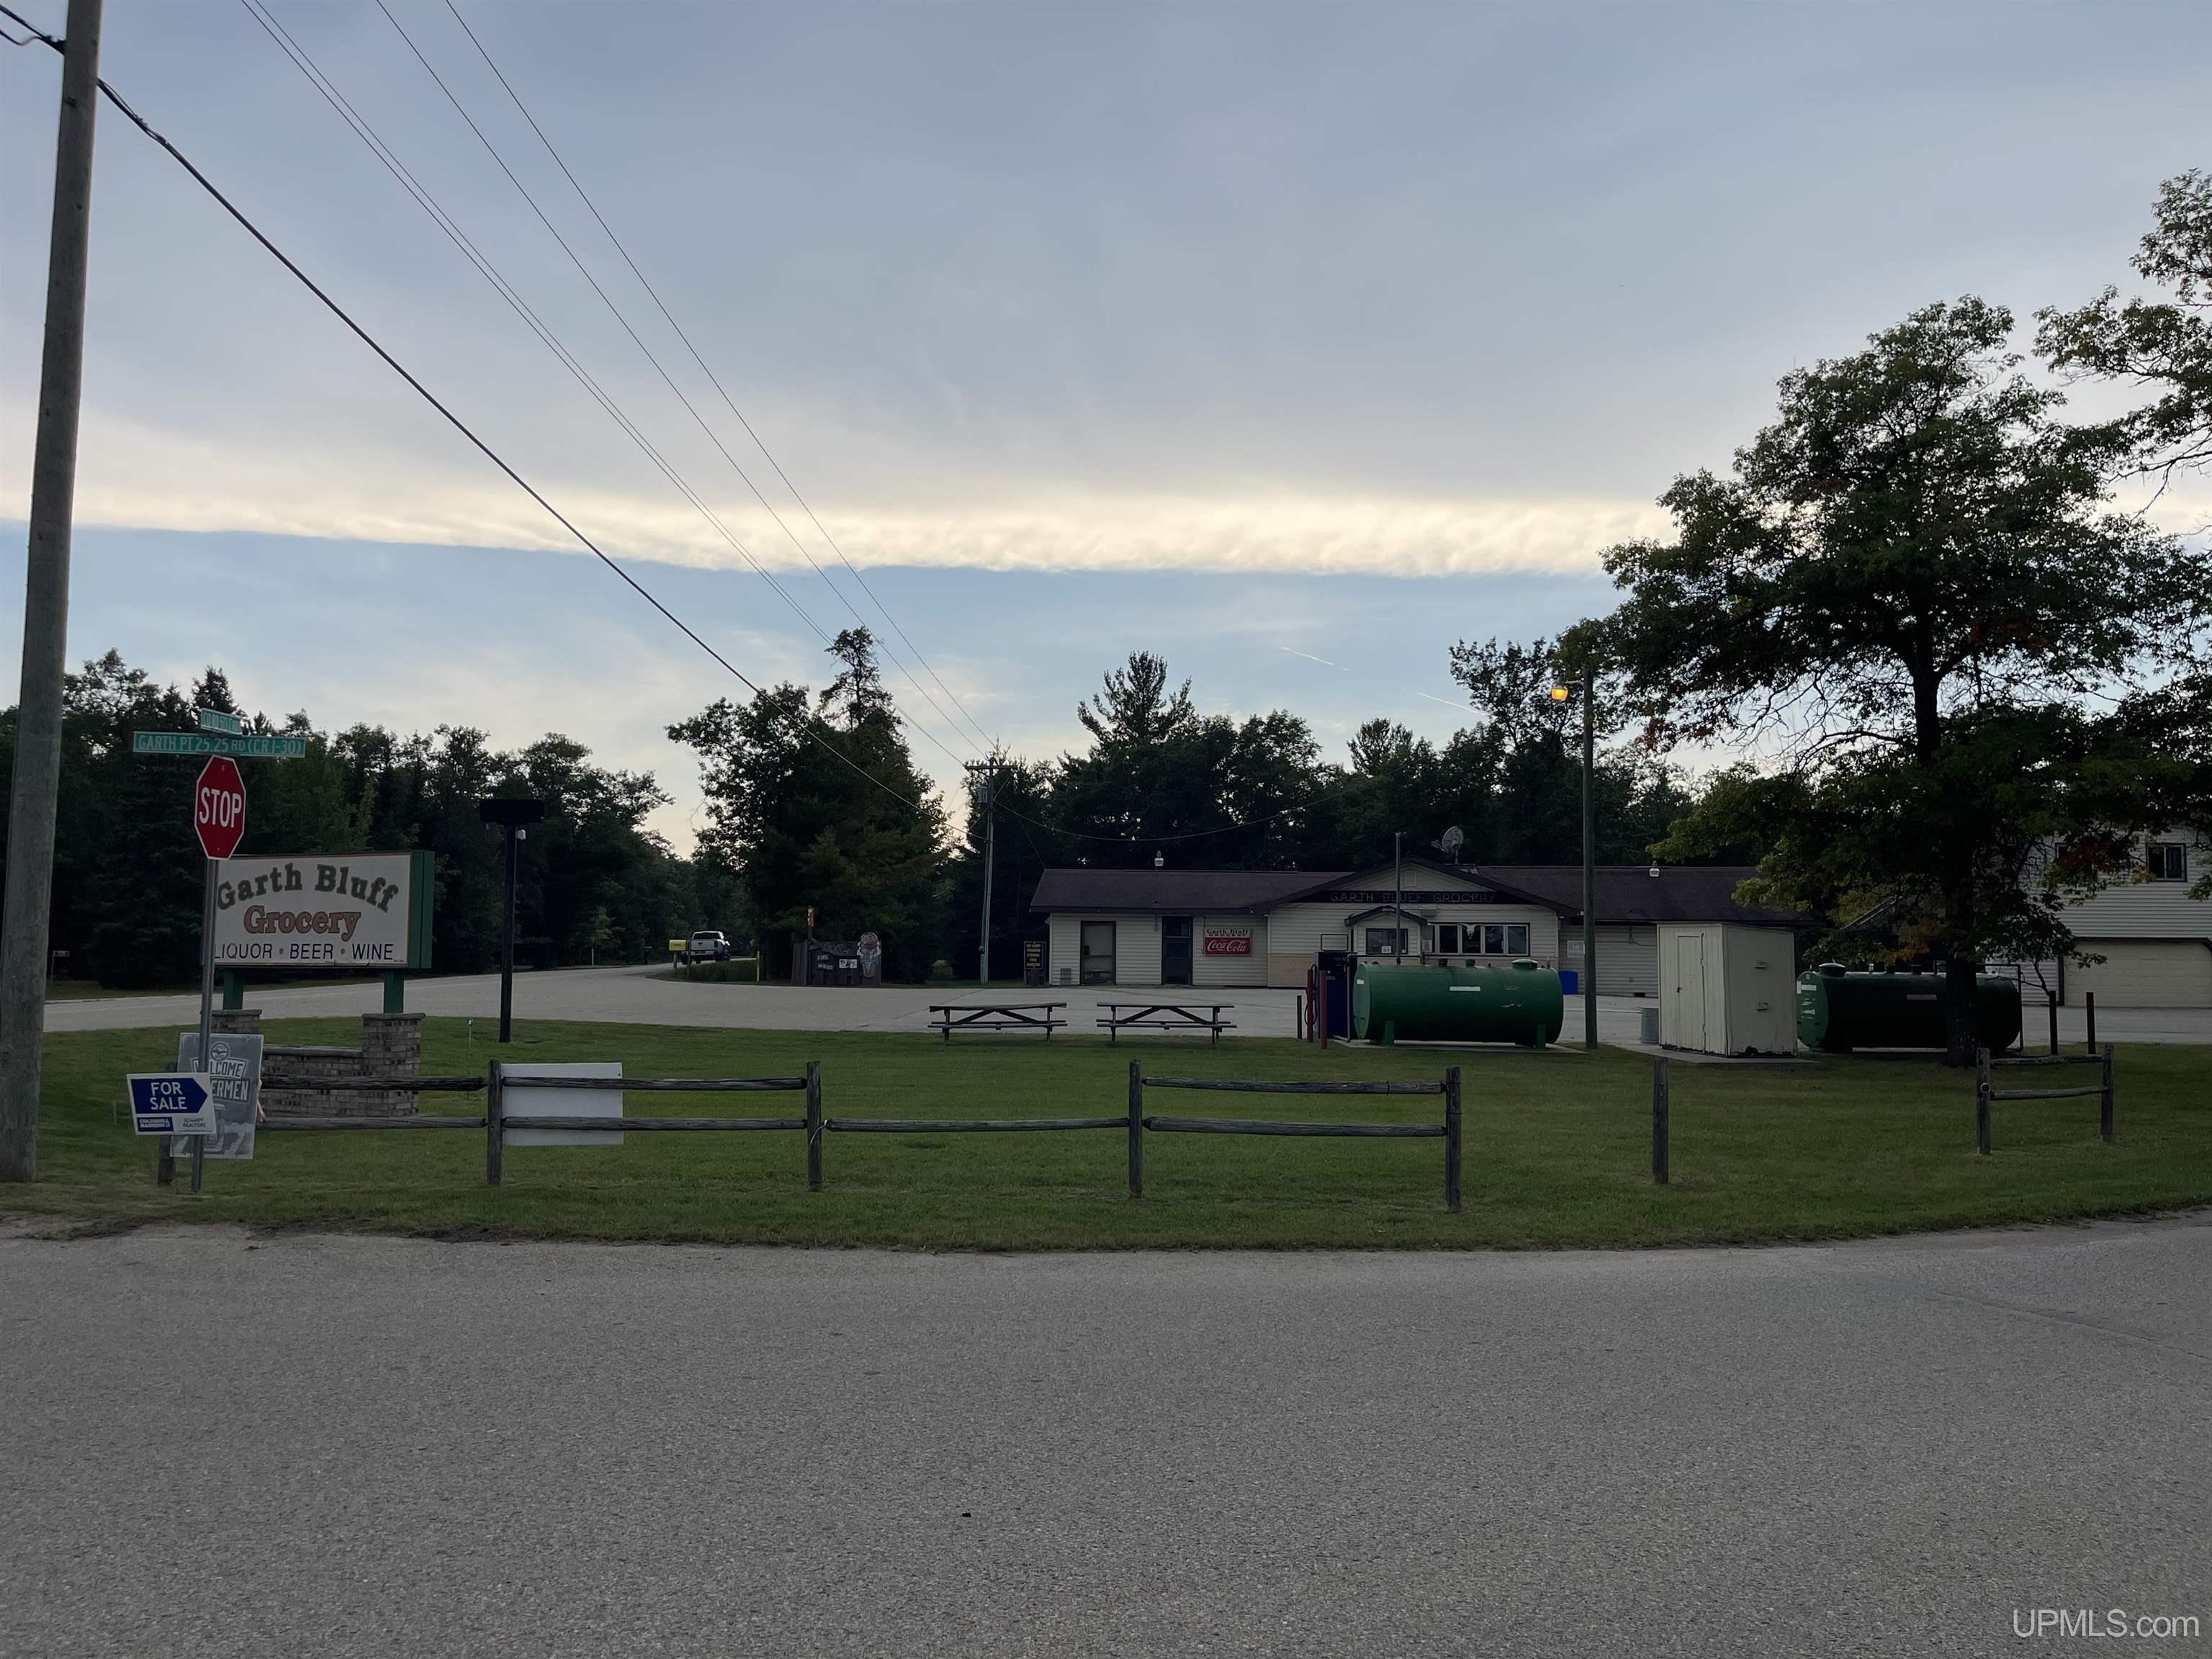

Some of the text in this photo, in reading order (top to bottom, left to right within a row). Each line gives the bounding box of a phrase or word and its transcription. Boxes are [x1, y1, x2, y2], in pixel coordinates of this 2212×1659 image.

[139, 735, 176, 750] GARTH
[180, 736, 194, 751] PT
[196, 737, 228, 752] 25.25
[230, 739, 245, 751] RD
[199, 787, 242, 828] STOP
[217, 863, 399, 913] Garth Bluff
[1330, 892, 1373, 902] GARTH
[1433, 893, 1496, 903] GROCERY
[243, 904, 361, 942] Grocery
[214, 943, 394, 960] LIQUOR BEER WINE
[195, 1061, 243, 1077] LCOME
[150, 1082, 182, 1096] FOR
[211, 1080, 248, 1100] ERMEN
[150, 1097, 187, 1110] SALE
